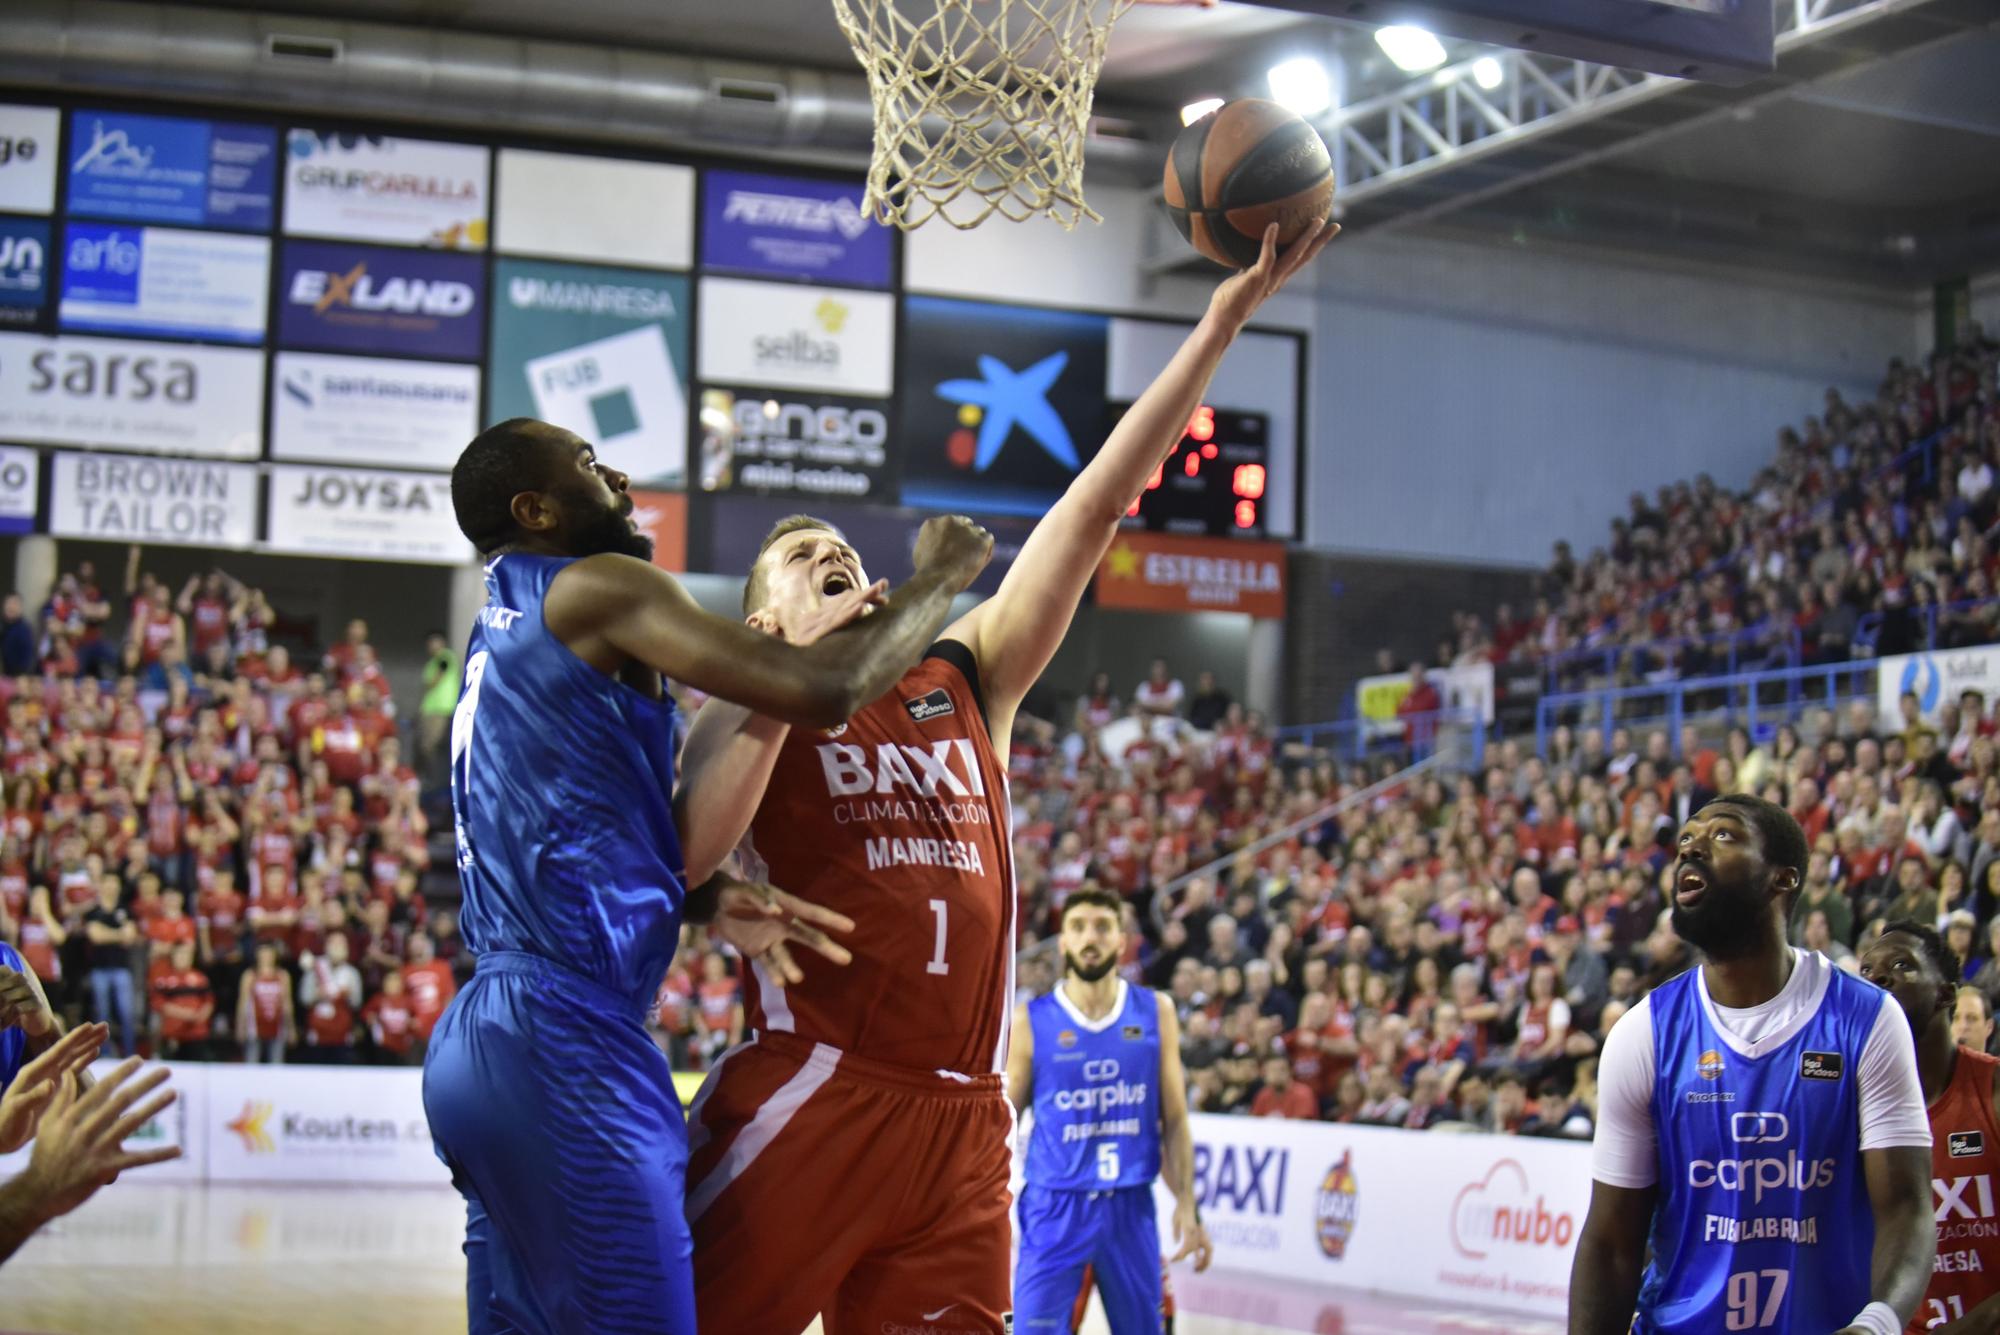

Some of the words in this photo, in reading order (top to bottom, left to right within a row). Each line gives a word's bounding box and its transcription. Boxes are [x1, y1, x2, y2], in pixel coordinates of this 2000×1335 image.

[0, 136, 38, 166] ge
[290, 262, 476, 317] EXLAND
[29, 350, 198, 404] sarsa
[75, 456, 229, 498] BROWN
[77, 501, 228, 538] TAILOR
[1144, 552, 1281, 592] ESTRELLA
[814, 738, 985, 798] BAXI
[865, 836, 985, 877] MANRESA
[926, 899, 949, 976] 1
[1054, 1080, 1147, 1115] carplus
[283, 1112, 433, 1141] Kouten.c
[1096, 1142, 1120, 1181] 5
[1192, 1143, 1288, 1216] BAXI
[1688, 1150, 1836, 1205] carplus
[1931, 1174, 1996, 1222] XI
[1936, 1220, 1999, 1242] ZACIÓN
[1932, 1249, 1984, 1273] RESA
[1725, 1268, 1789, 1332] 97
